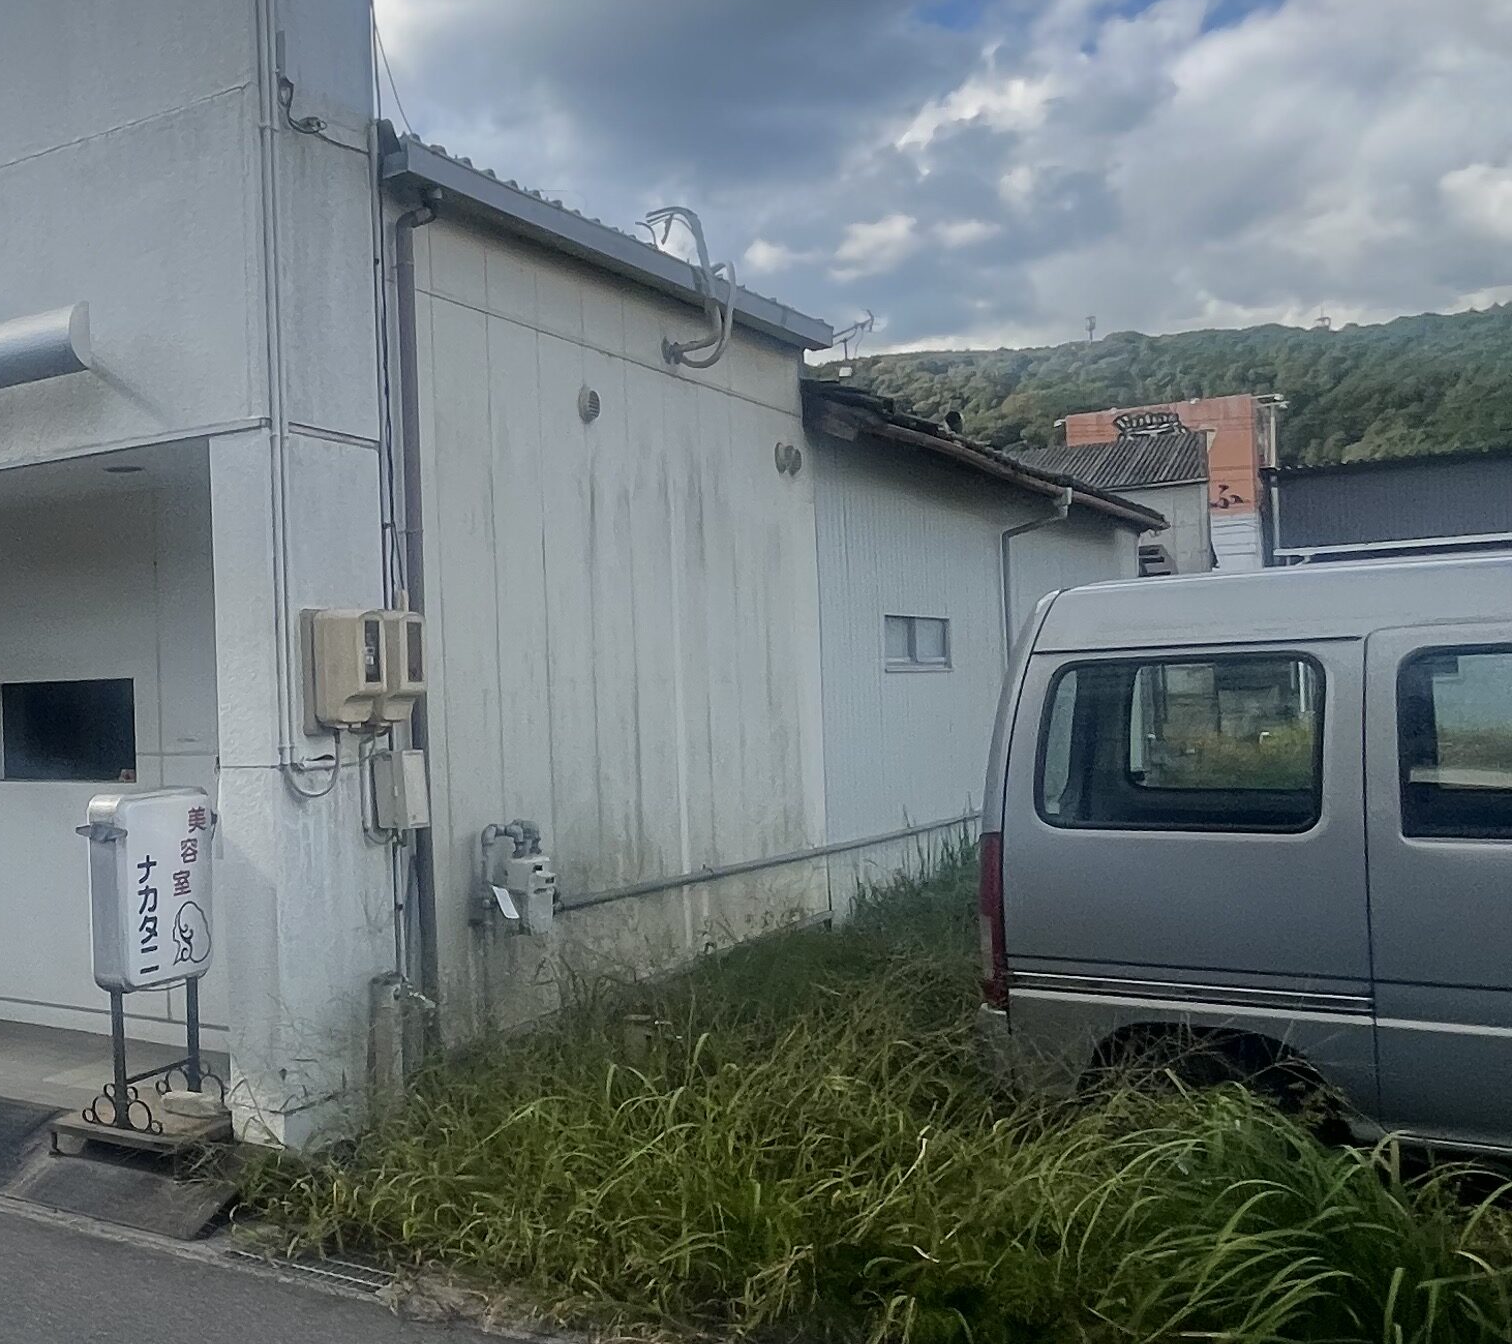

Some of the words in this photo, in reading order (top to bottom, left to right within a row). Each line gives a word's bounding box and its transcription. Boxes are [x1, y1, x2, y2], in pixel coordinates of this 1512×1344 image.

[172, 806, 208, 897] 美容室
[137, 854, 160, 975] ナカタニ
